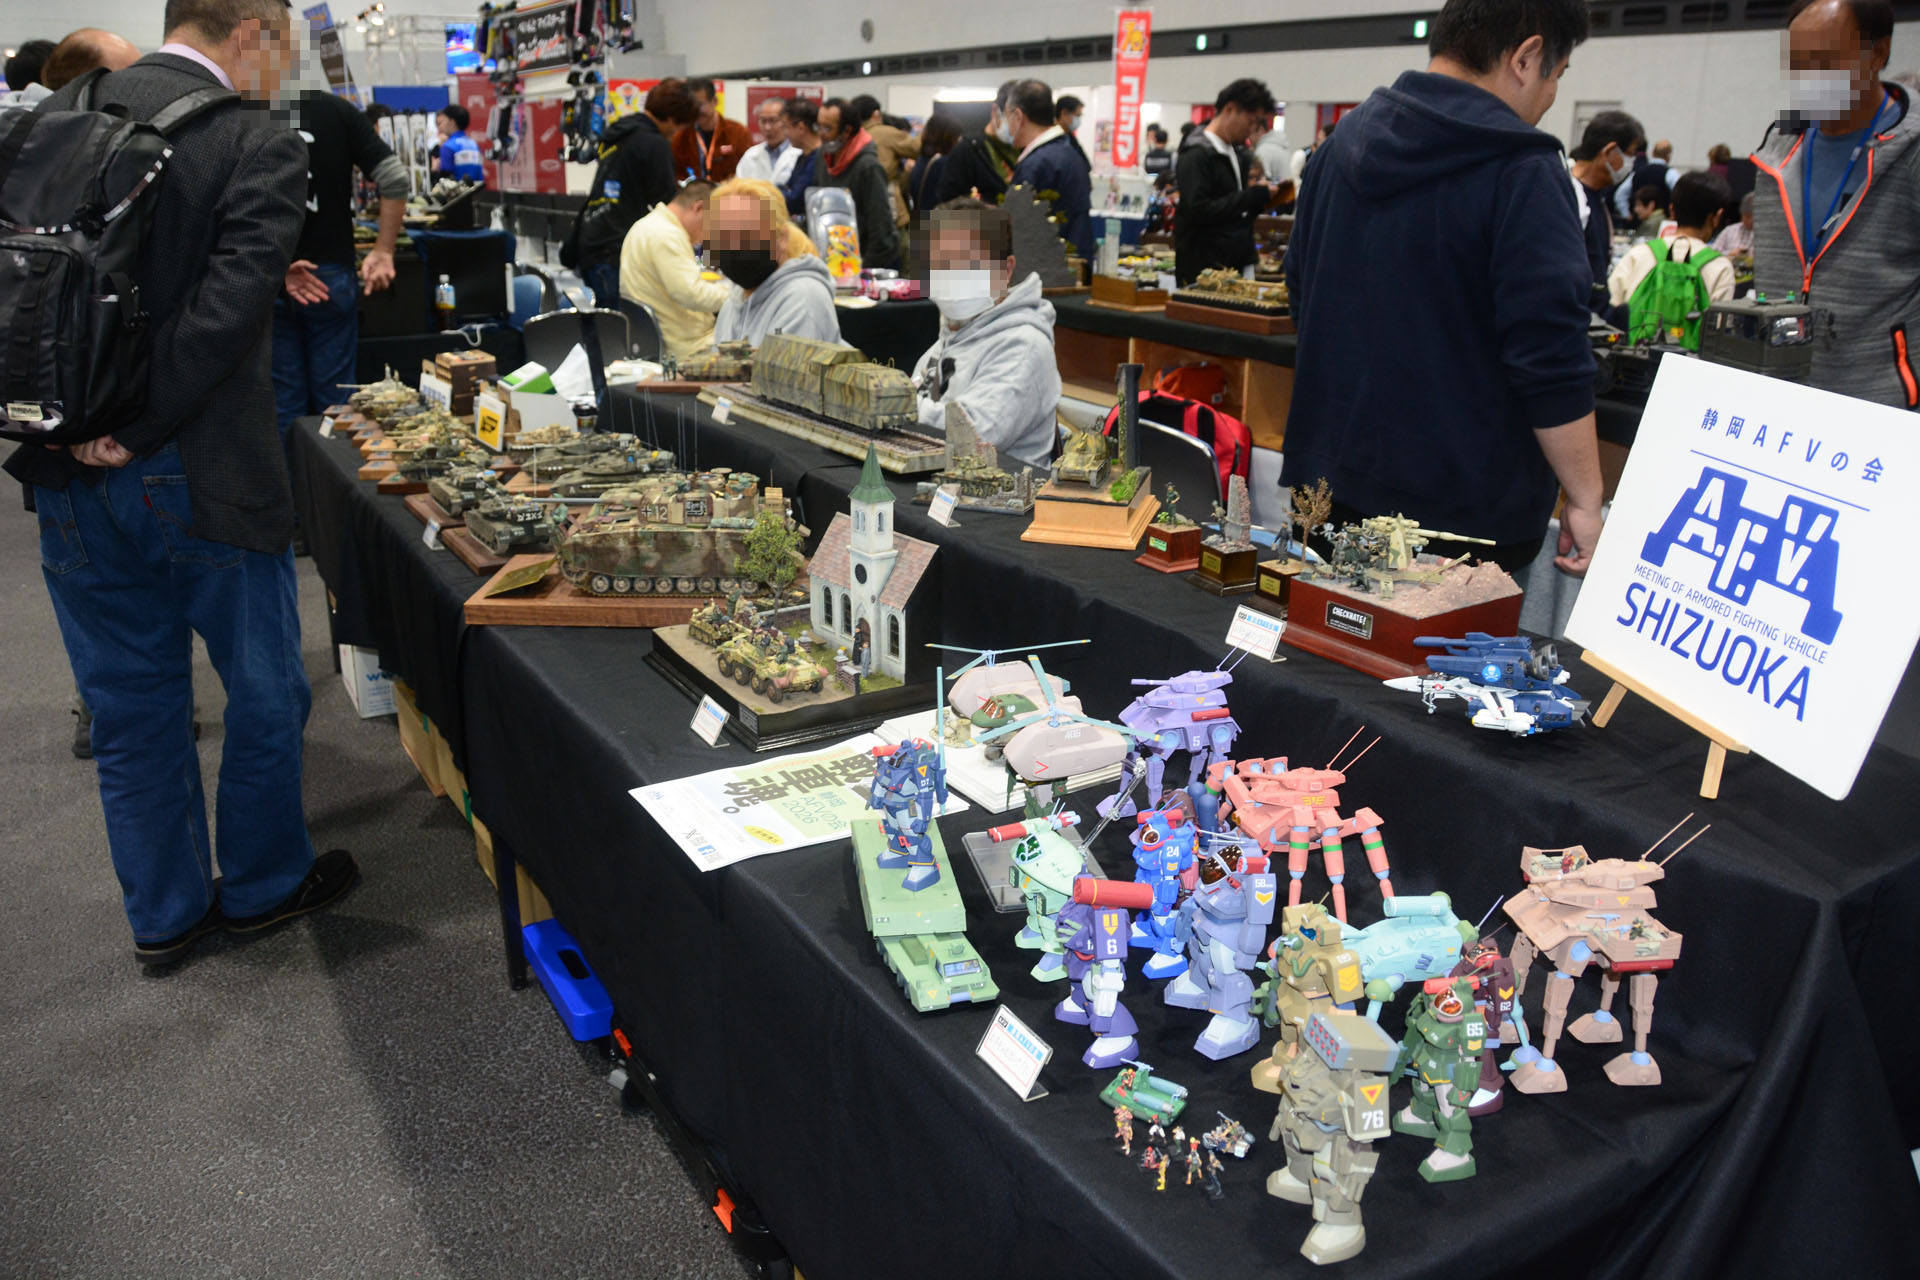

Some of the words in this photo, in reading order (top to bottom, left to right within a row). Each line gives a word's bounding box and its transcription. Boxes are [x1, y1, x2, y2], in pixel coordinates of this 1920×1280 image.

[1701, 408, 1884, 483] 静岡AFVの会
[1634, 563, 1670, 593] MEETING
[1671, 582, 1684, 596] OF
[1685, 588, 1732, 619] ARMORED
[1732, 609, 1780, 642] FIGHTING
[1783, 633, 1828, 664] VEHICLE
[1616, 581, 1811, 723] SHIZUOKA
[1192, 735, 1201, 747] 5
[1166, 846, 1180, 858] 24
[1106, 938, 1118, 955] 6
[1500, 1001, 1512, 1011] 62
[1466, 1022, 1484, 1037] 65
[1361, 1108, 1384, 1131] 76
